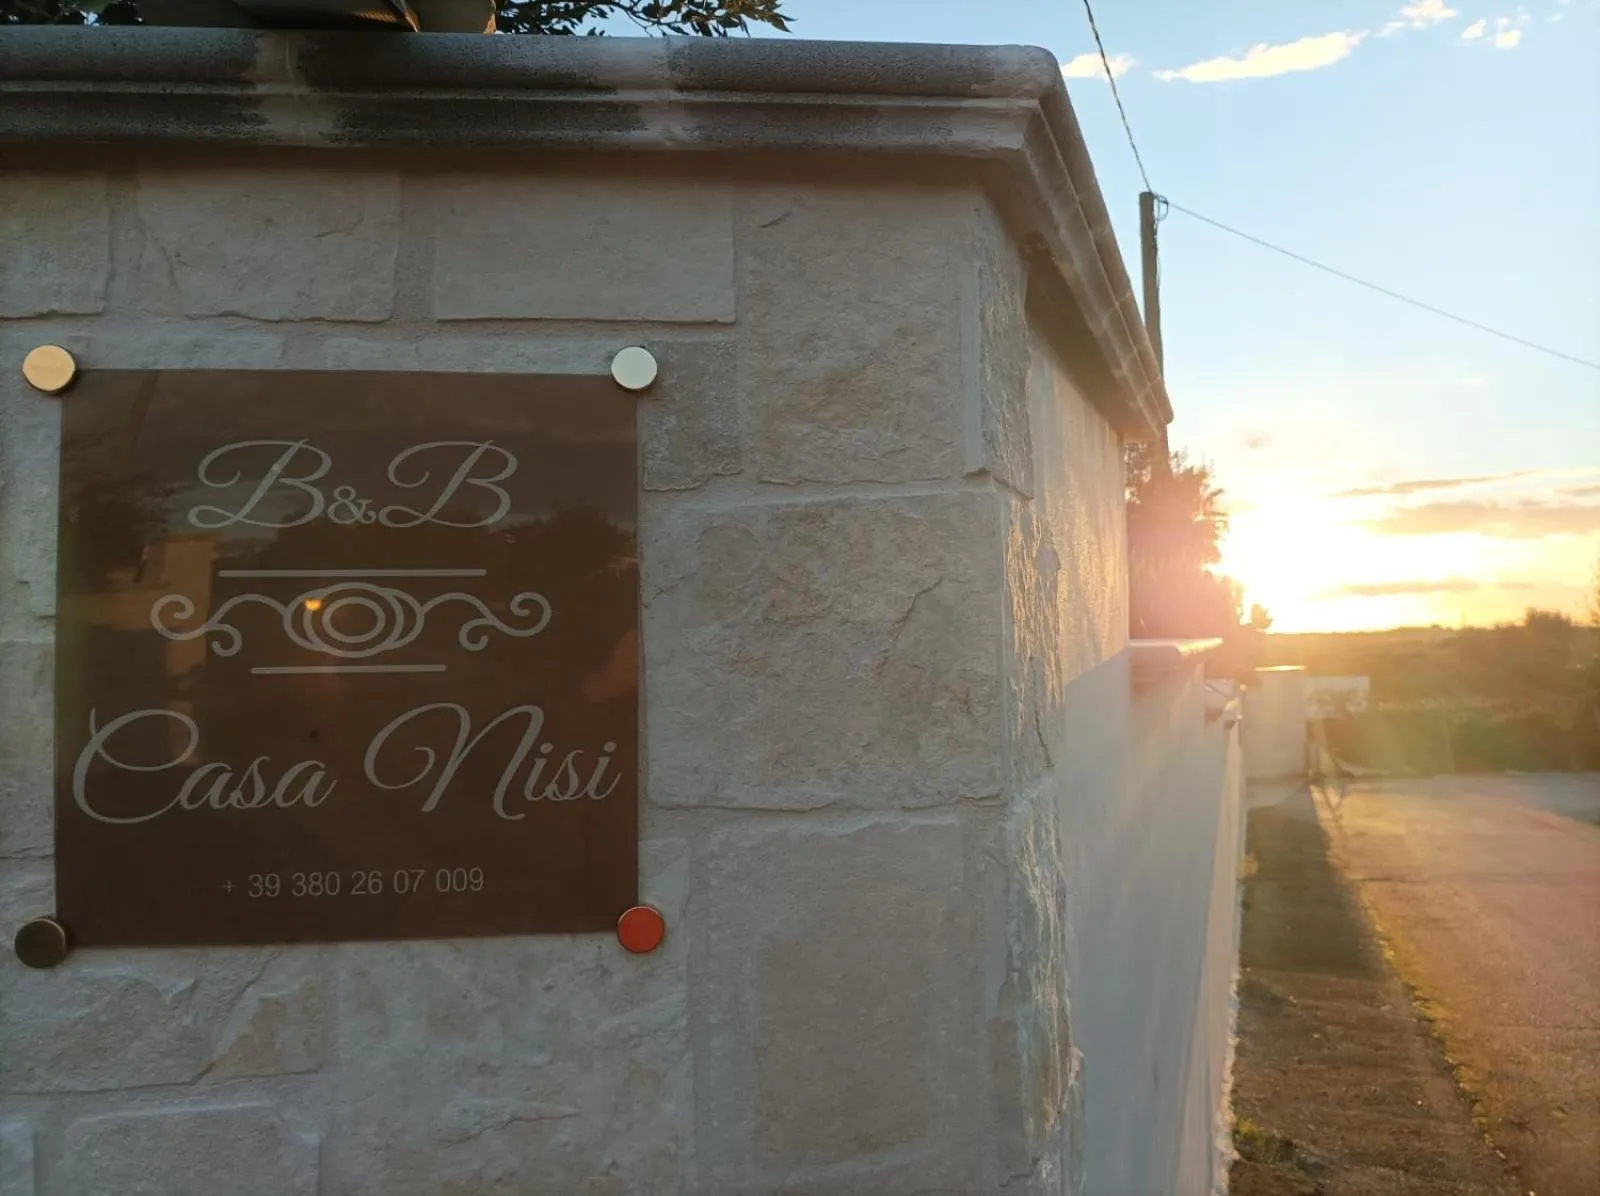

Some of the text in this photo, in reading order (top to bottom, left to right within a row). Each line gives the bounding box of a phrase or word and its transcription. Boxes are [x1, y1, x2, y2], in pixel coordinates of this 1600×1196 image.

[187, 438, 519, 528] B&B
[72, 702, 622, 825] Casa Nisi
[247, 873, 282, 898] 39
[290, 871, 341, 897] 380
[350, 869, 384, 896] 26
[392, 868, 426, 894] 07
[435, 866, 485, 893] 009
